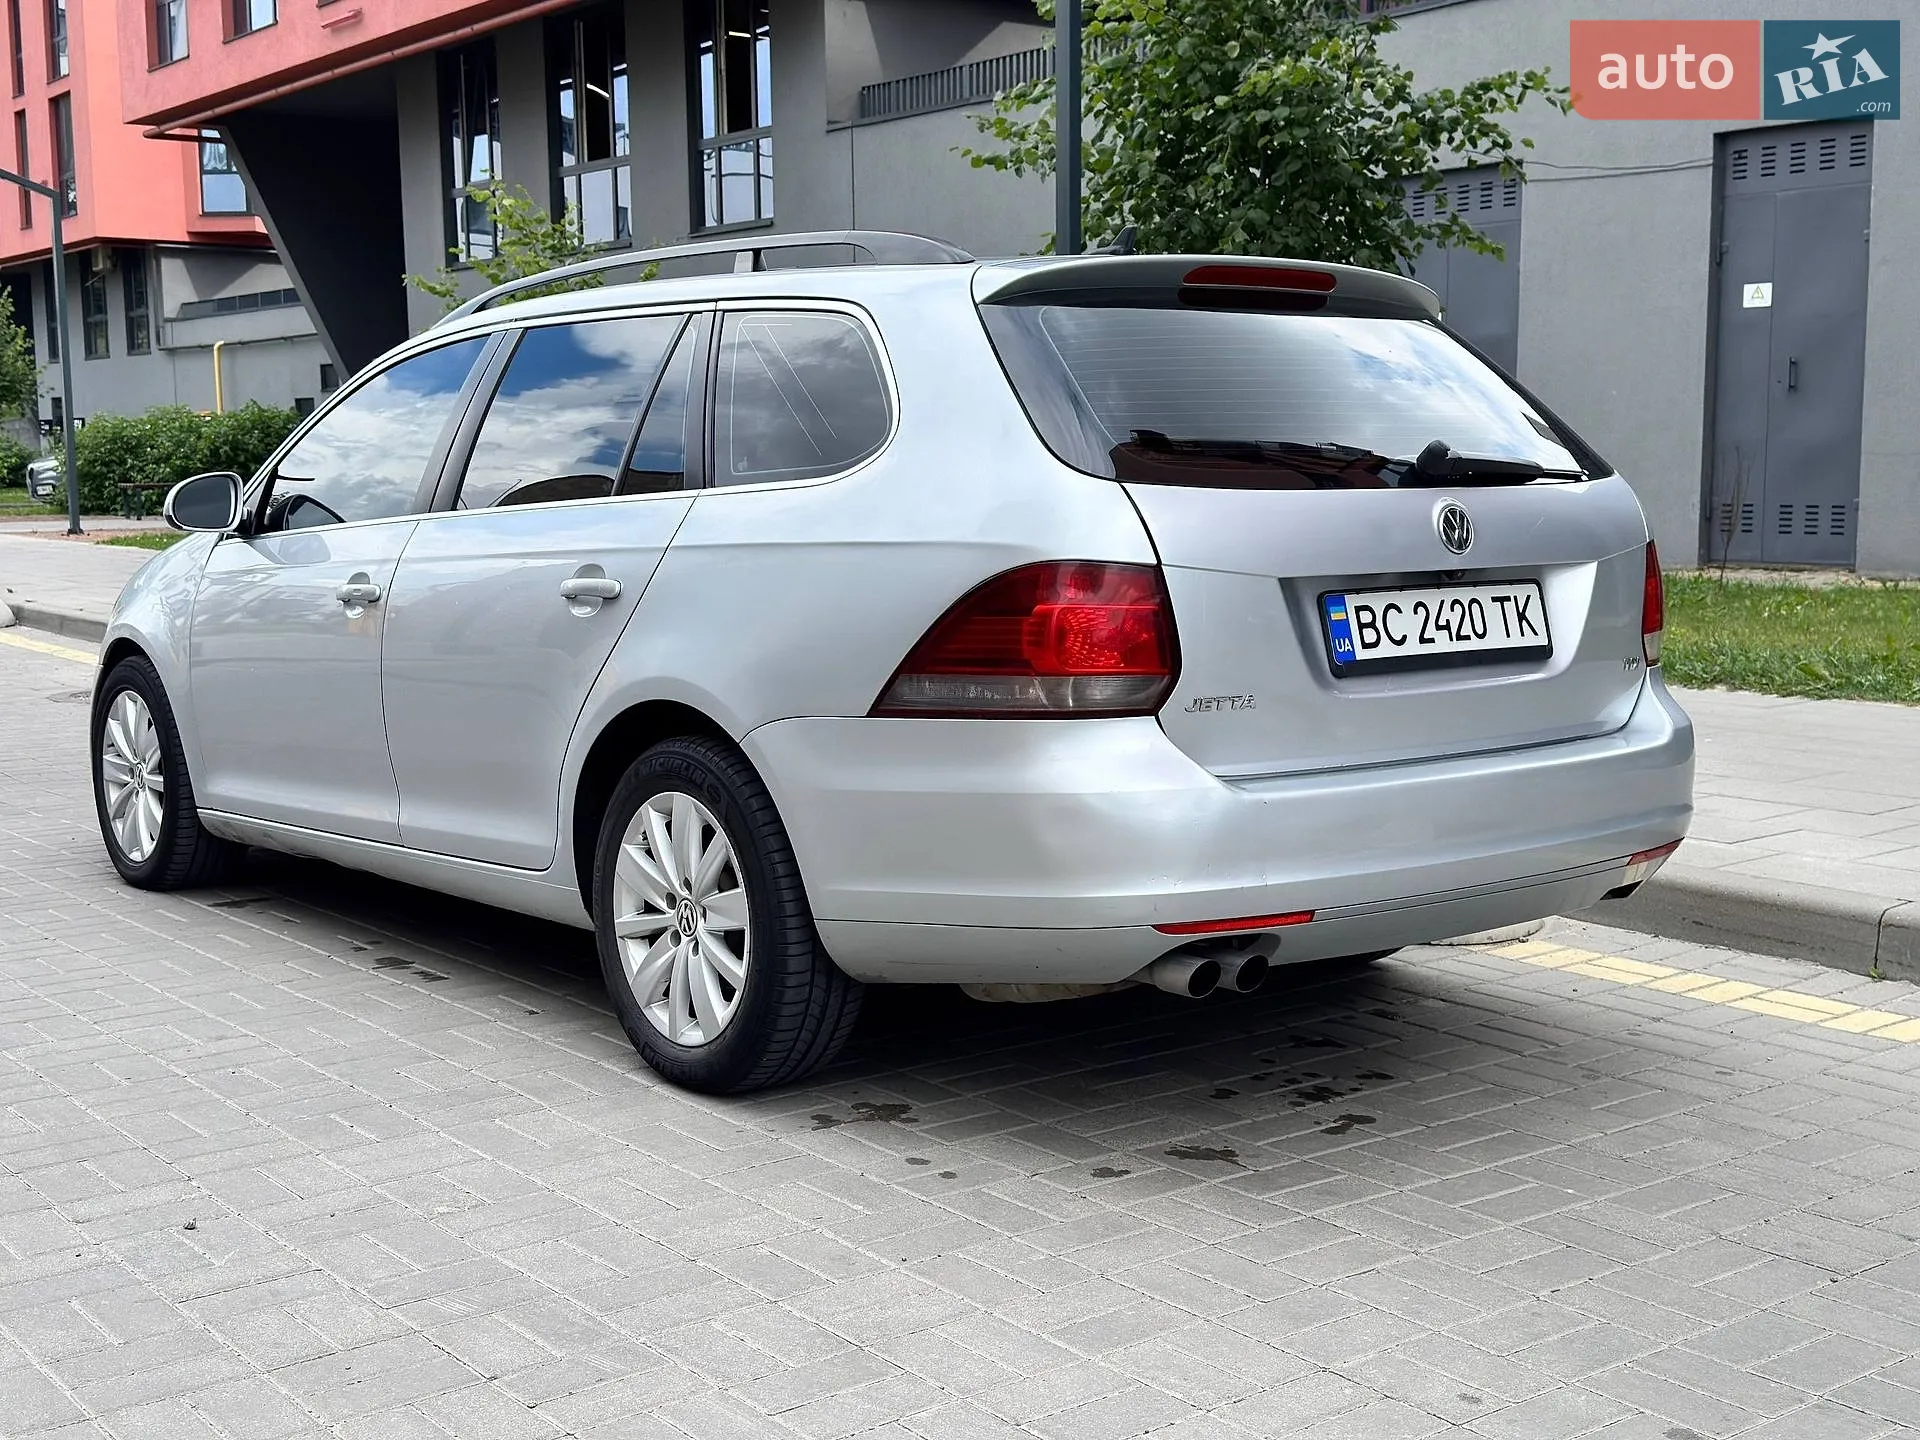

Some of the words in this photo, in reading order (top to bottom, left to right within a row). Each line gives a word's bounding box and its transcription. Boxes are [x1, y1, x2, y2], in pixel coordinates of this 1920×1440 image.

[1354, 603, 1407, 650] BC
[1413, 598, 1488, 644] 2420
[1491, 594, 1539, 638] TK
[1335, 638, 1353, 653] UA
[1185, 694, 1256, 713] JETTA
